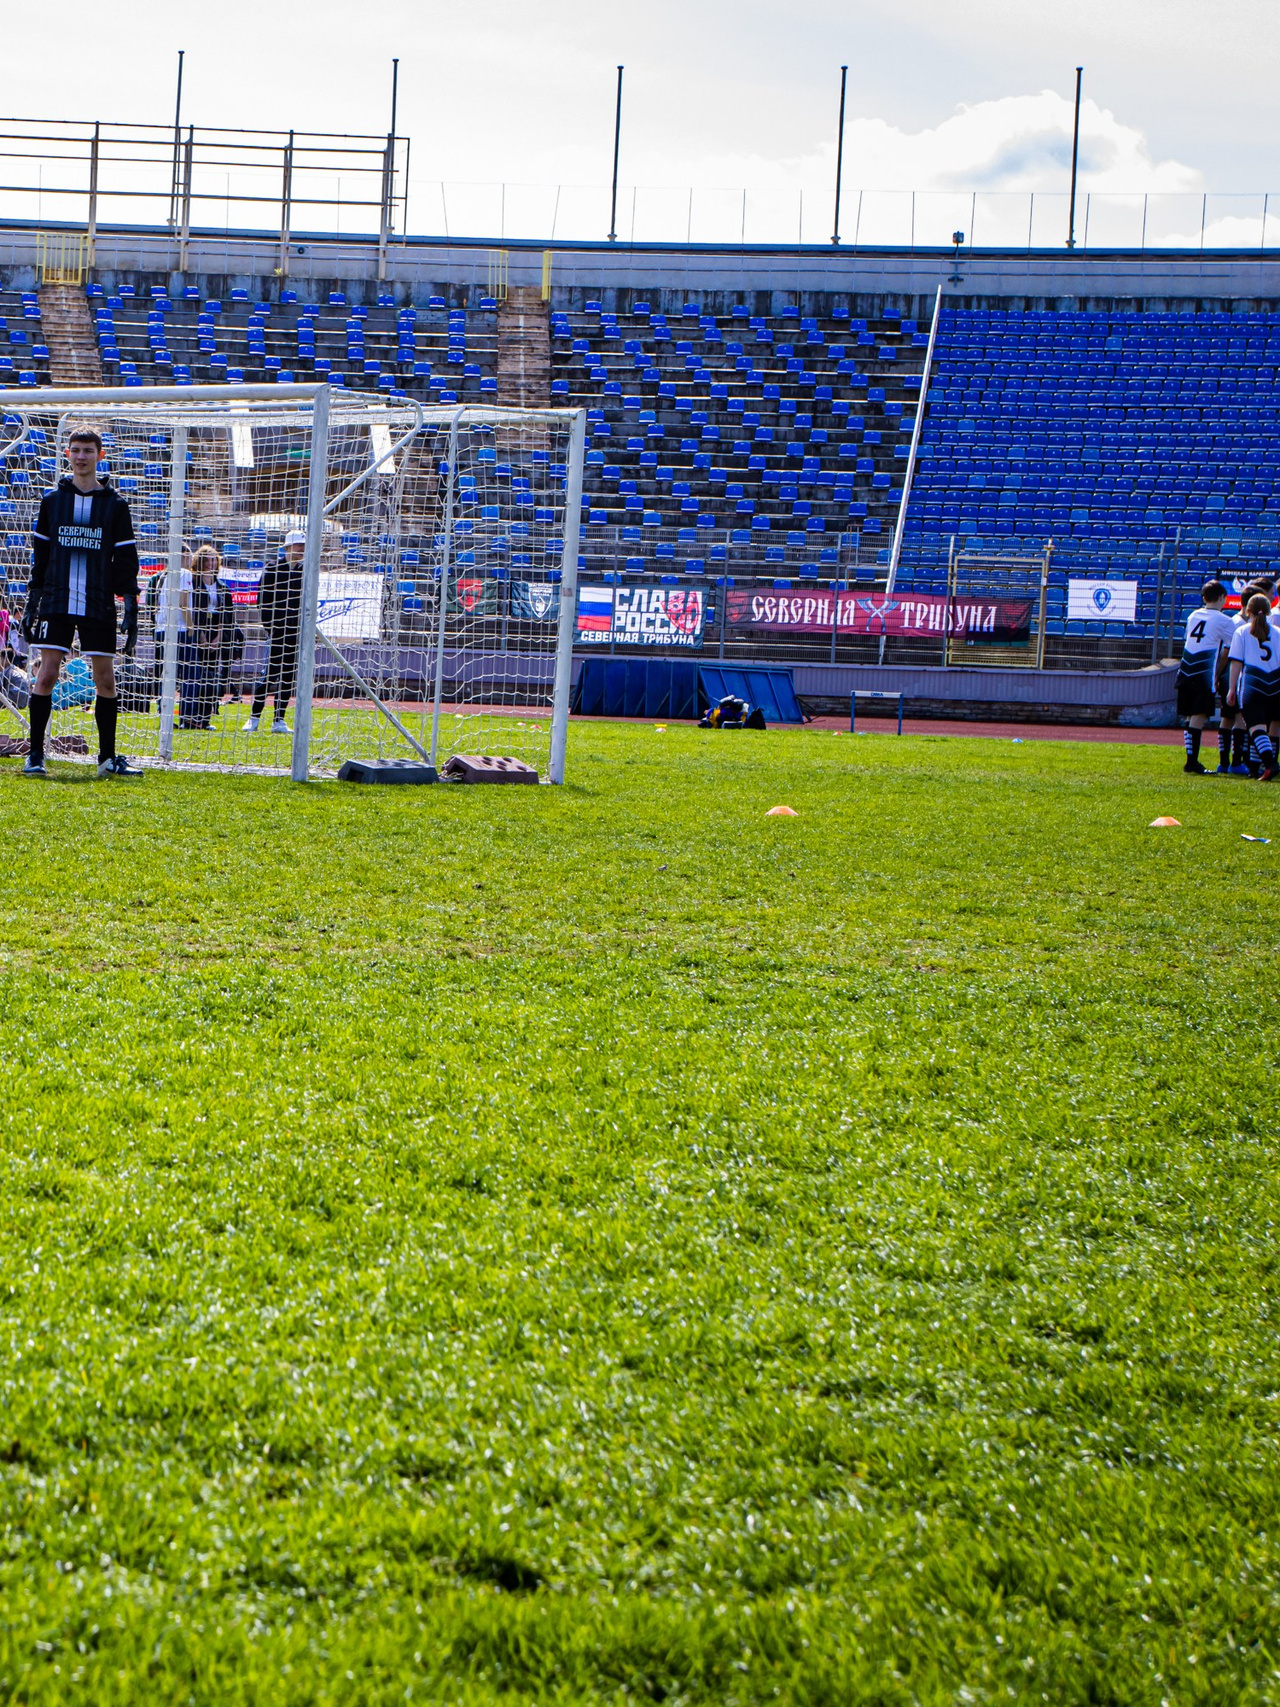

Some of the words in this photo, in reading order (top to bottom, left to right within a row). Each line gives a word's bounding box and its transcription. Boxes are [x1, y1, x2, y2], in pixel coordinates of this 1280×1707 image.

[58, 525, 102, 539] СЕВЕРНЫЙ
[58, 536, 102, 550] ЧЕЛОВЕК
[615, 588, 702, 613] СЛАВА
[614, 611, 702, 635] РОССИИ
[751, 595, 856, 626] СЕВЕРНАЯ
[900, 601, 998, 632] ТРИБУНА
[581, 630, 639, 643] СЕВЕРНАЯ
[642, 633, 694, 645] ТРИБУНА
[1190, 620, 1207, 644] 4
[1258, 631, 1272, 662] 5
